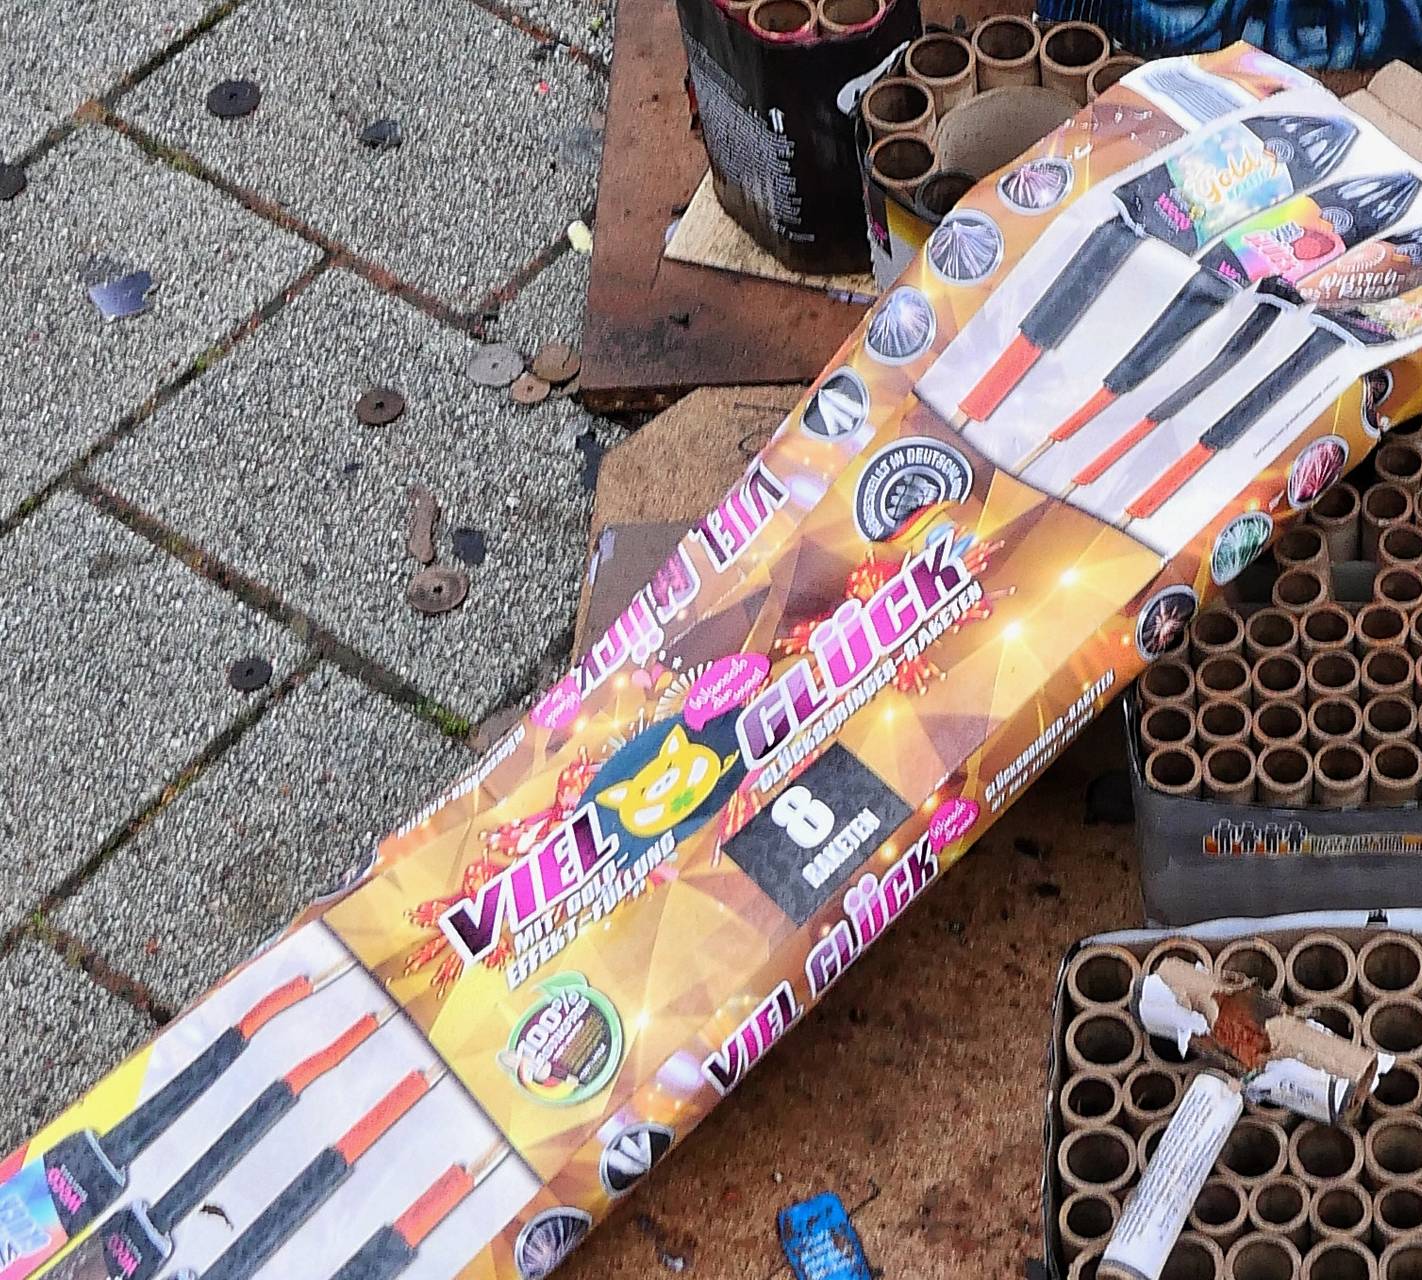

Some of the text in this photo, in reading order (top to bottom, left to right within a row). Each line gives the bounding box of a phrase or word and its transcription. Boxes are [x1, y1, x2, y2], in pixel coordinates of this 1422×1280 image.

[438, 532, 972, 971] VIEL GLÜCK
[771, 785, 835, 849] 8
[801, 807, 881, 890] RAKETEN
[505, 829, 676, 992] EFFEKT-FÜLLUNG
[513, 910, 561, 957] MIT
[701, 830, 939, 1097] VIEL GLÜCK
[515, 988, 581, 1060] 100%
